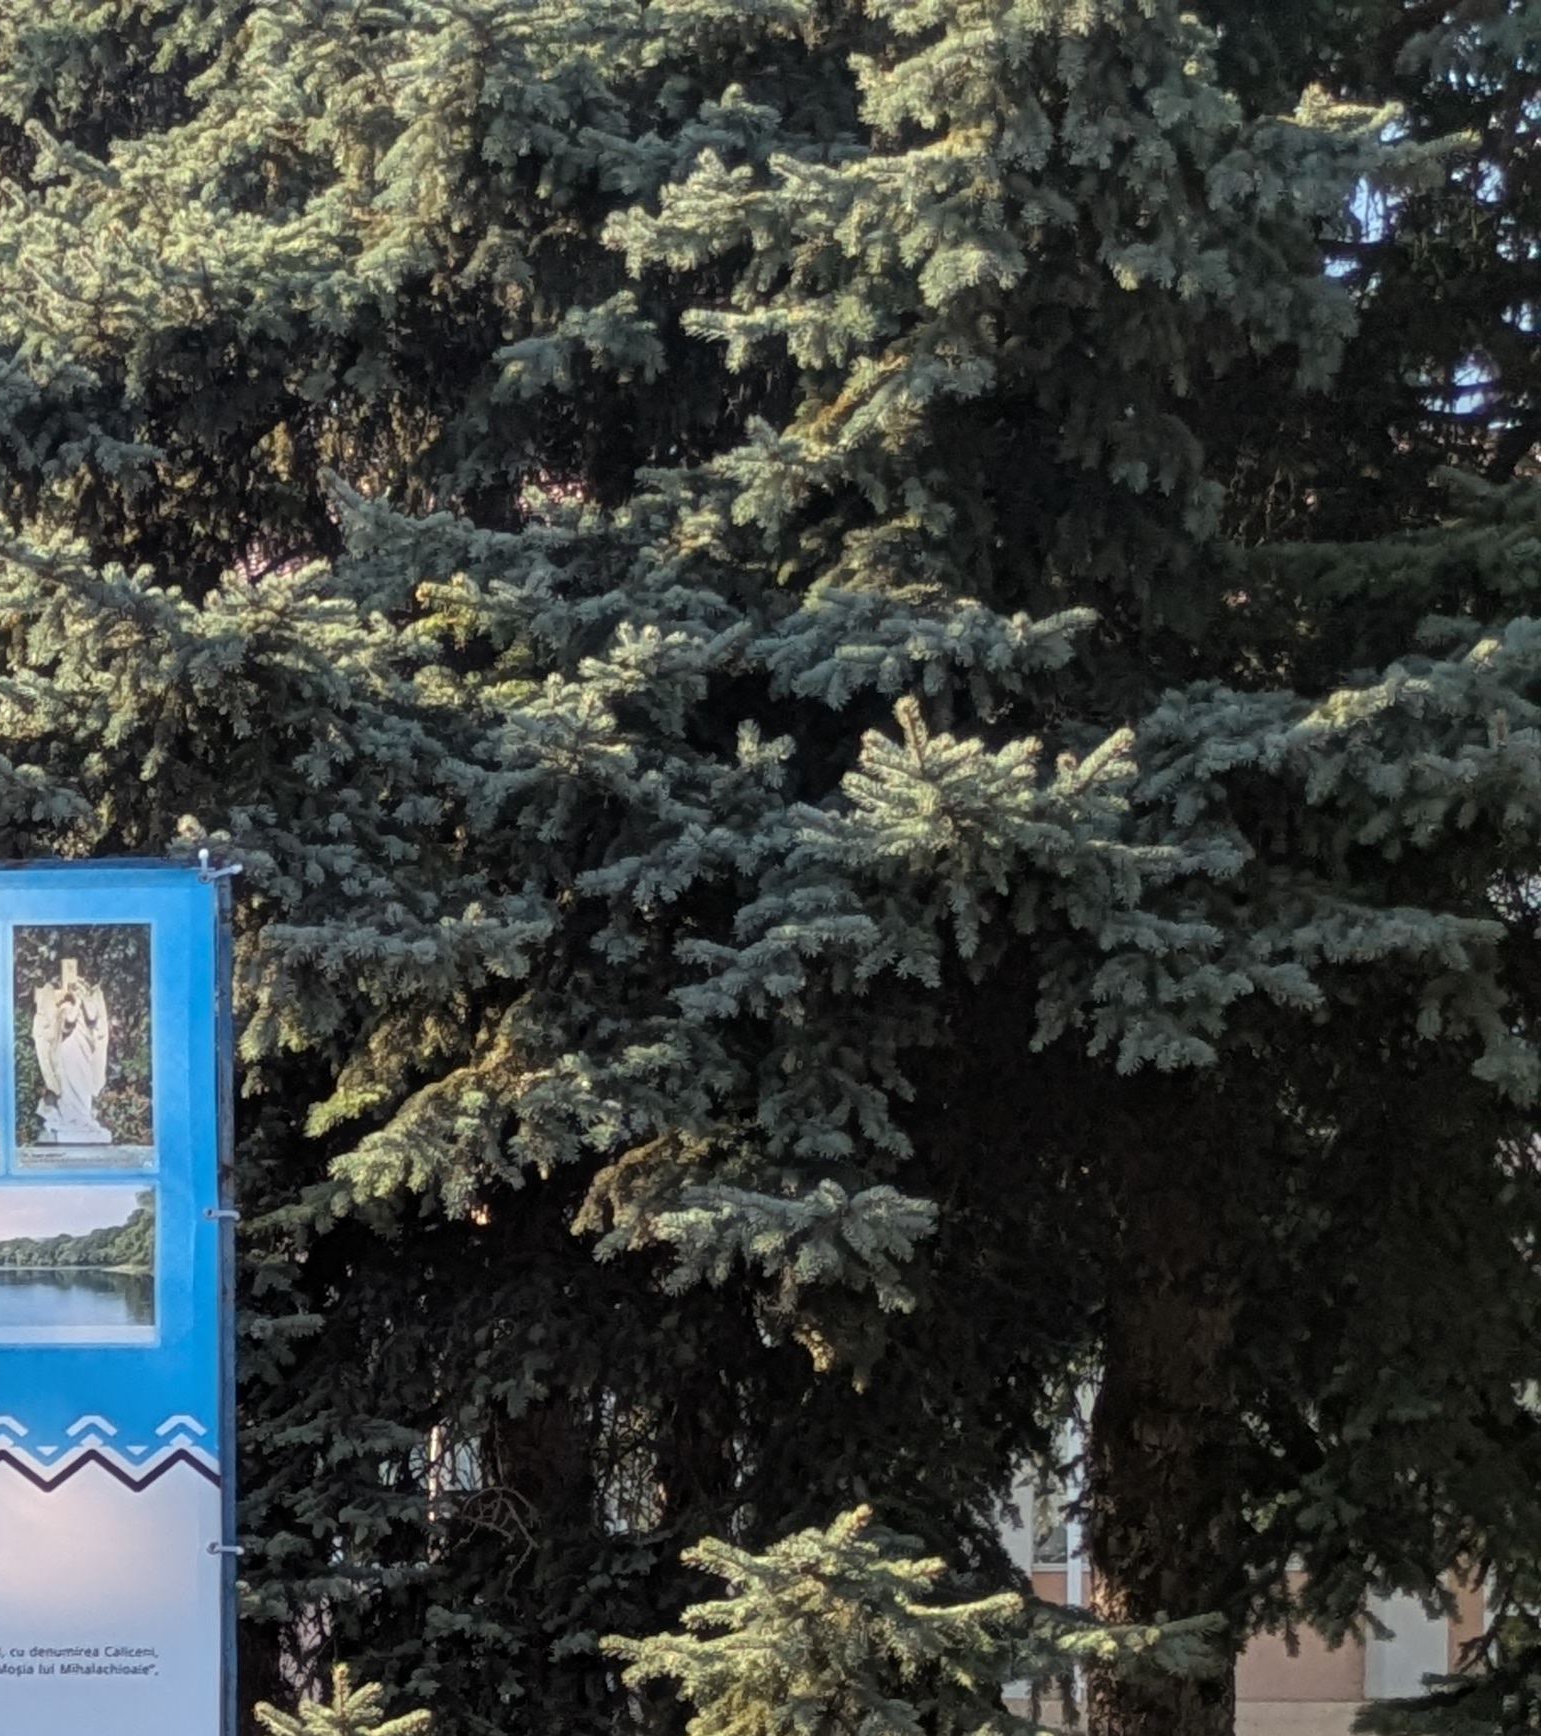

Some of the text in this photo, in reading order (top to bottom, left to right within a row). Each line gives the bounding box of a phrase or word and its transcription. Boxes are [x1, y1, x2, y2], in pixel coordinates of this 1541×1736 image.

[9, 1648, 26, 1658] cu
[28, 1646, 101, 1658] denumirea
[37, 1663, 56, 1675] lui
